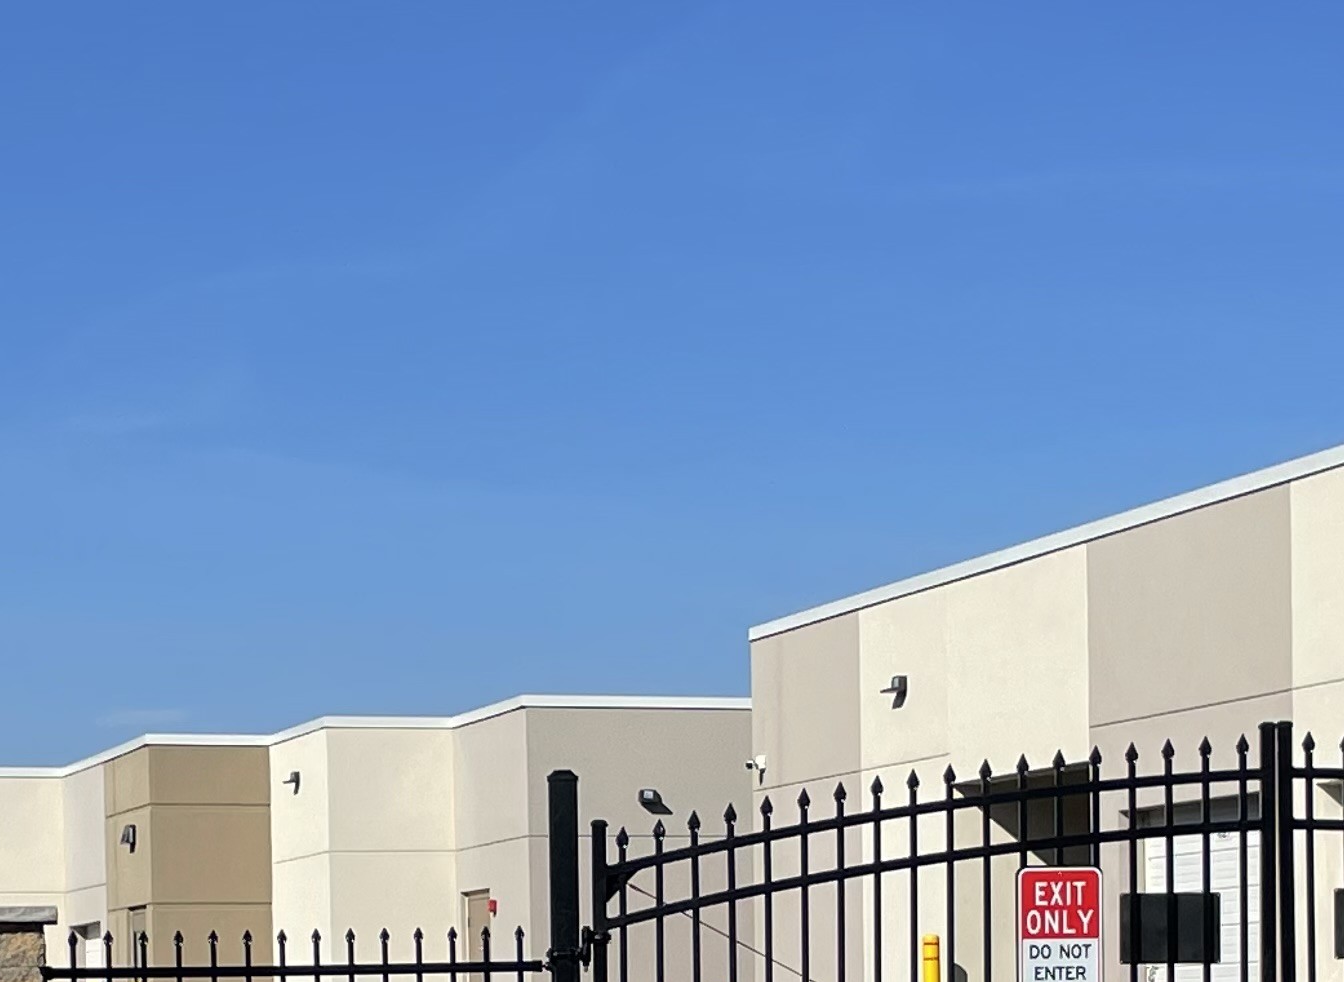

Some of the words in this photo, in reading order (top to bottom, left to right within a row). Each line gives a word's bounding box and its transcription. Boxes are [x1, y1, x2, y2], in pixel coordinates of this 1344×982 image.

[1034, 881, 1087, 906] EXIT
[1026, 909, 1094, 934] ONLY
[1029, 944, 1051, 959] DO
[1059, 944, 1092, 959] NOT
[1034, 966, 1087, 981] ENTER
